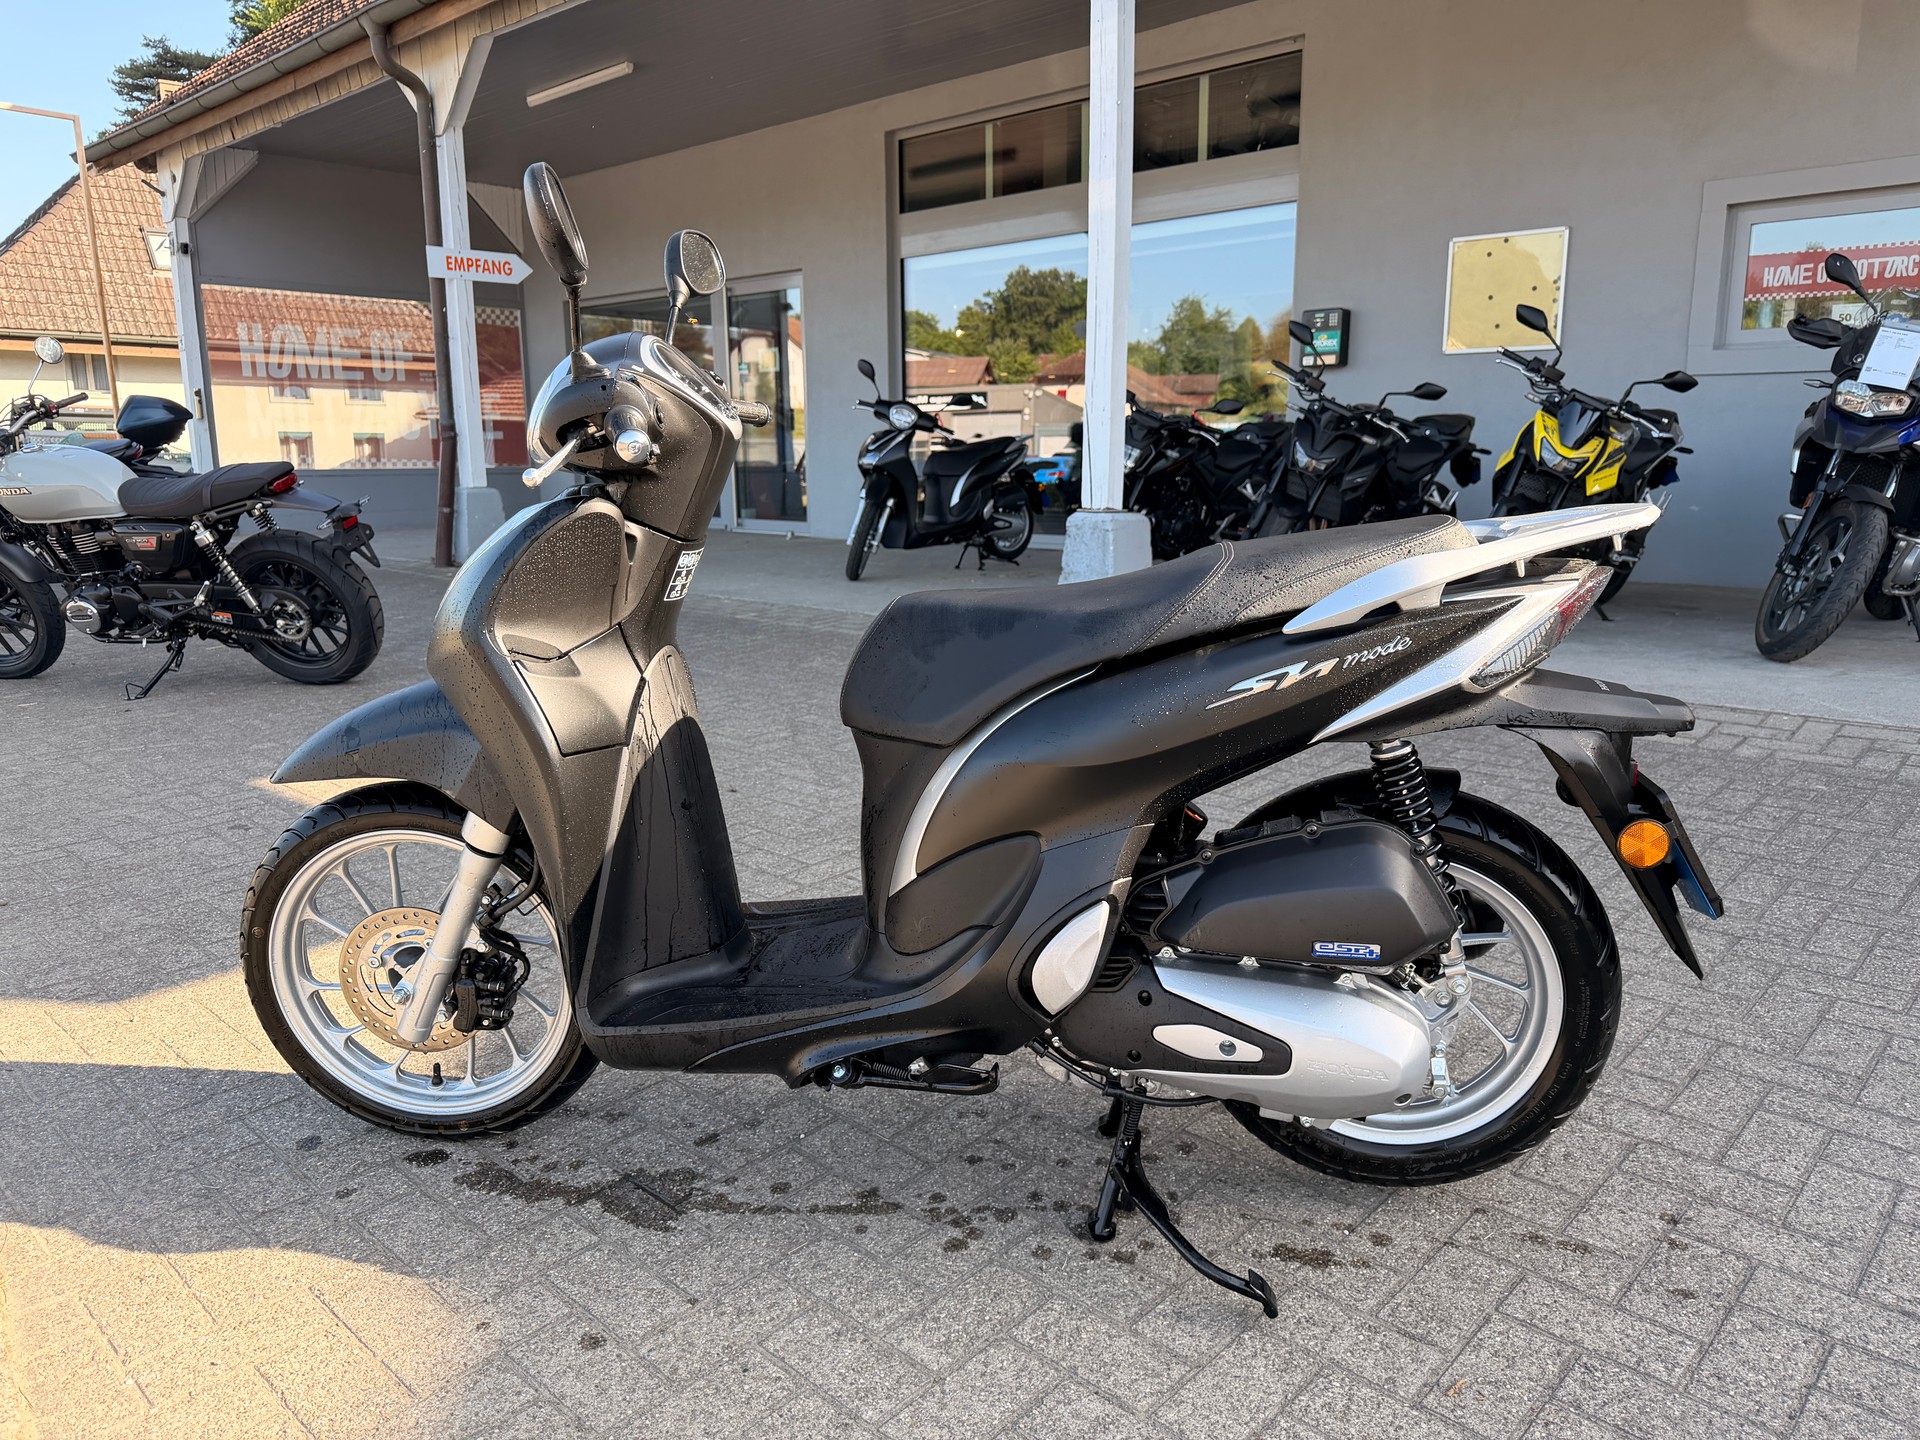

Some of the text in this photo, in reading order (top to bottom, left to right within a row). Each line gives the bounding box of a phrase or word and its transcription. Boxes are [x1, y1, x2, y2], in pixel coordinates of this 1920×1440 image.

[445, 255, 513, 277] EMPFANG
[1838, 313, 1852, 322] 50
[370, 328, 414, 382] OF
[1342, 635, 1413, 669] mode
[1304, 1058, 1390, 1082] HONDA
